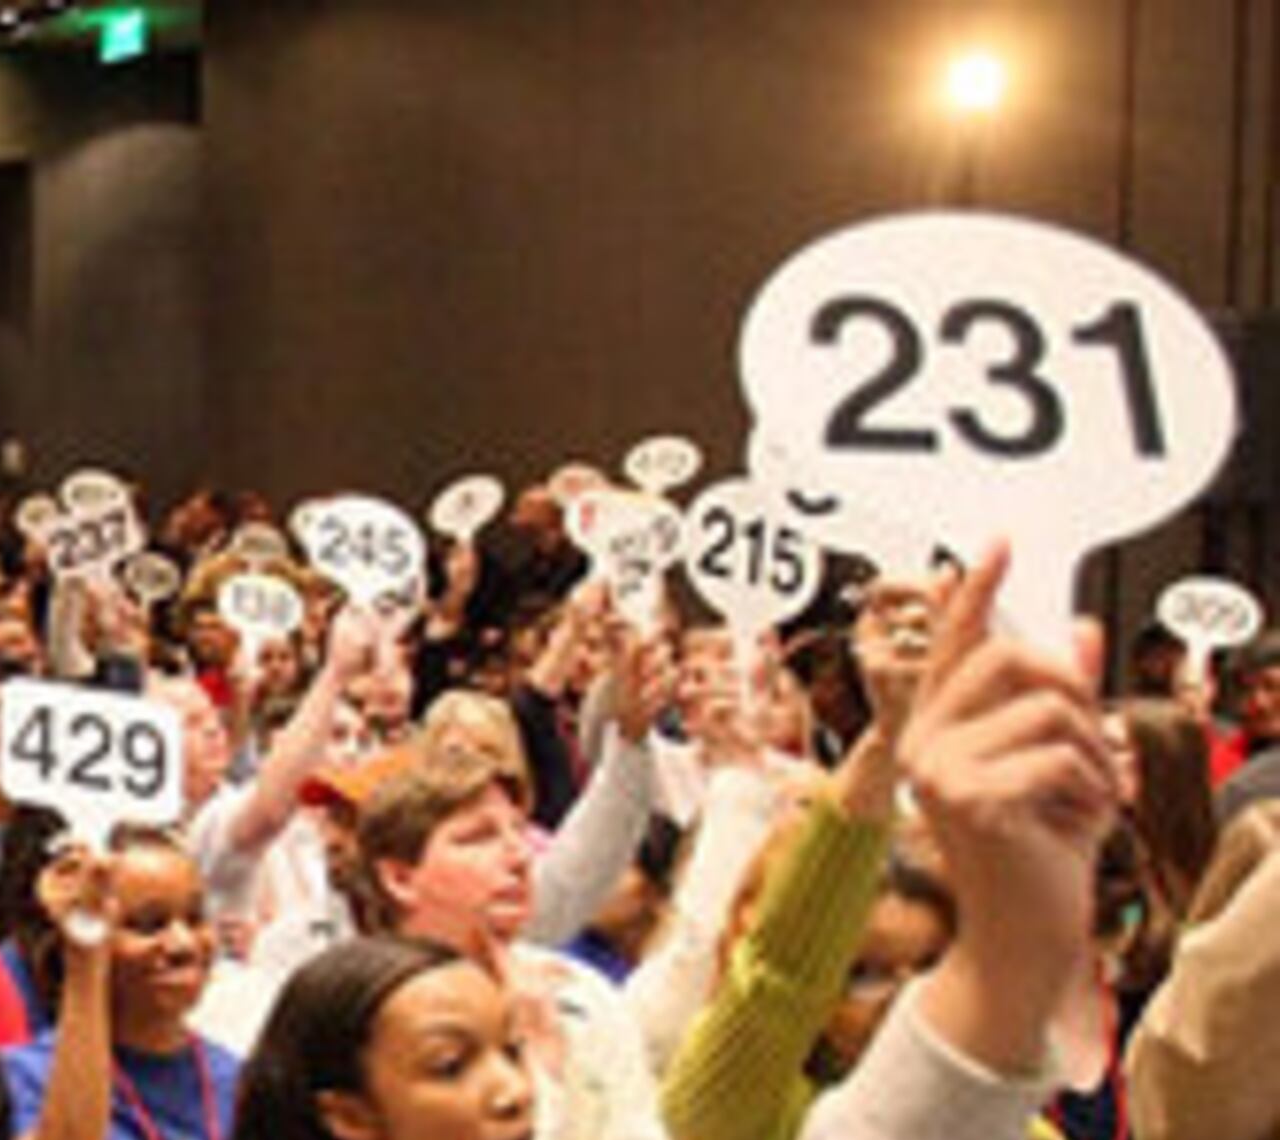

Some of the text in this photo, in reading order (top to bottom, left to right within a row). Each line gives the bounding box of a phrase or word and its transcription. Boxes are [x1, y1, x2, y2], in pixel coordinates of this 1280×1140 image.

[809, 295, 1167, 461] 231
[316, 513, 412, 578] 245
[696, 505, 806, 597] 215
[9, 705, 167, 800] 429
